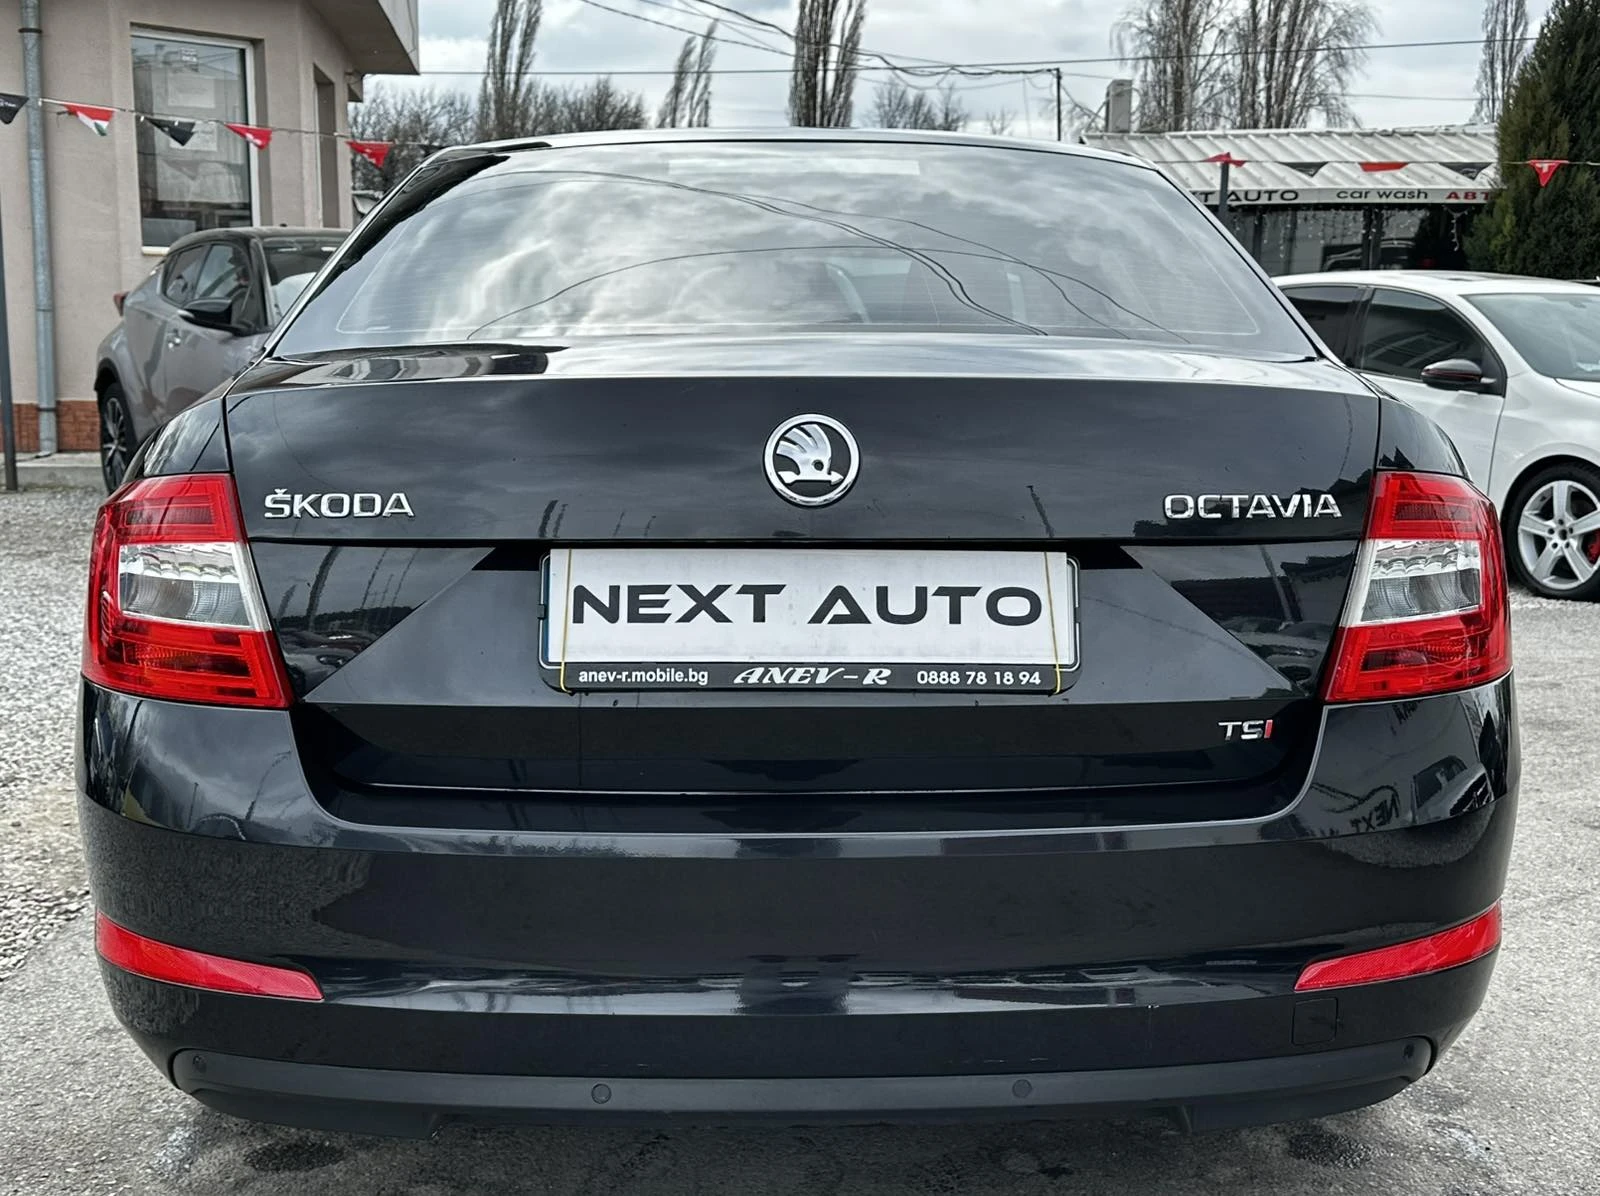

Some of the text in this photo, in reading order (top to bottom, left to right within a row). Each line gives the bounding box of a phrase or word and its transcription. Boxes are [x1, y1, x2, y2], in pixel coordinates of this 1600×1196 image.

[1227, 190, 1299, 202] AUTO
[1336, 188, 1428, 199] car wash
[264, 488, 415, 518] ŠKODA
[1164, 493, 1343, 519] OCTAVIA
[572, 584, 1042, 626] NEXT AUTO
[578, 668, 709, 686] anev-r.mobile.bg
[917, 670, 1041, 685] 0888 78 18 94
[1218, 719, 1273, 741] TSI
